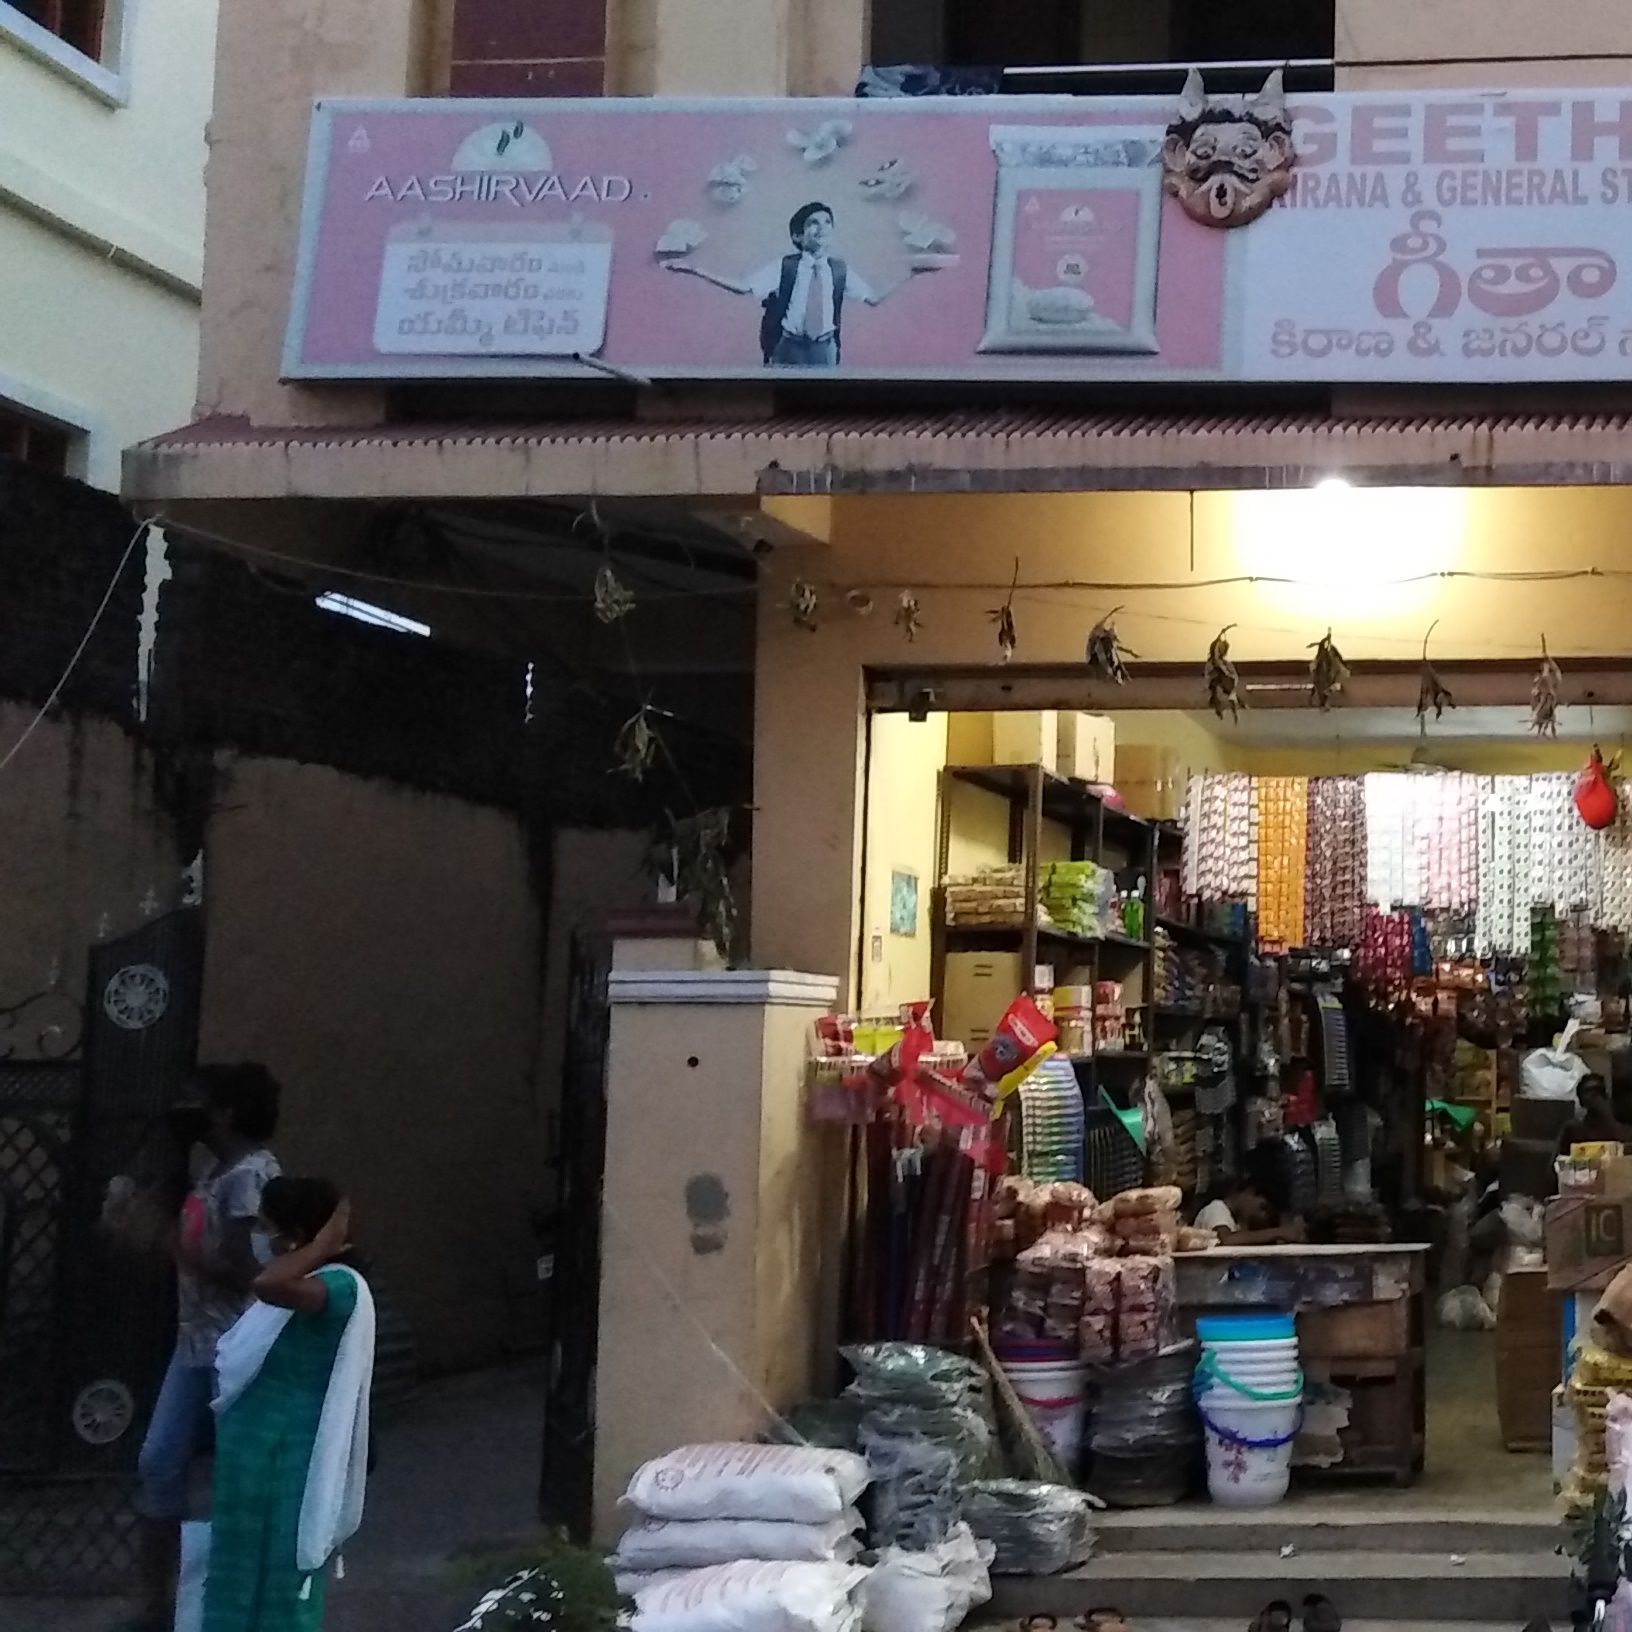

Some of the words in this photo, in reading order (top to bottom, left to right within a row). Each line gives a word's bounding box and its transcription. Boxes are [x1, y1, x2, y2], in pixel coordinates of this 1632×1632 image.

[365, 174, 634, 207] AASHIRVAAD
[1401, 170, 1422, 208] &
[1435, 168, 1589, 208] GENERAL
[1372, 209, 1618, 319] గీతా
[1405, 320, 1447, 359] &
[1460, 315, 1611, 360] జనరల్
